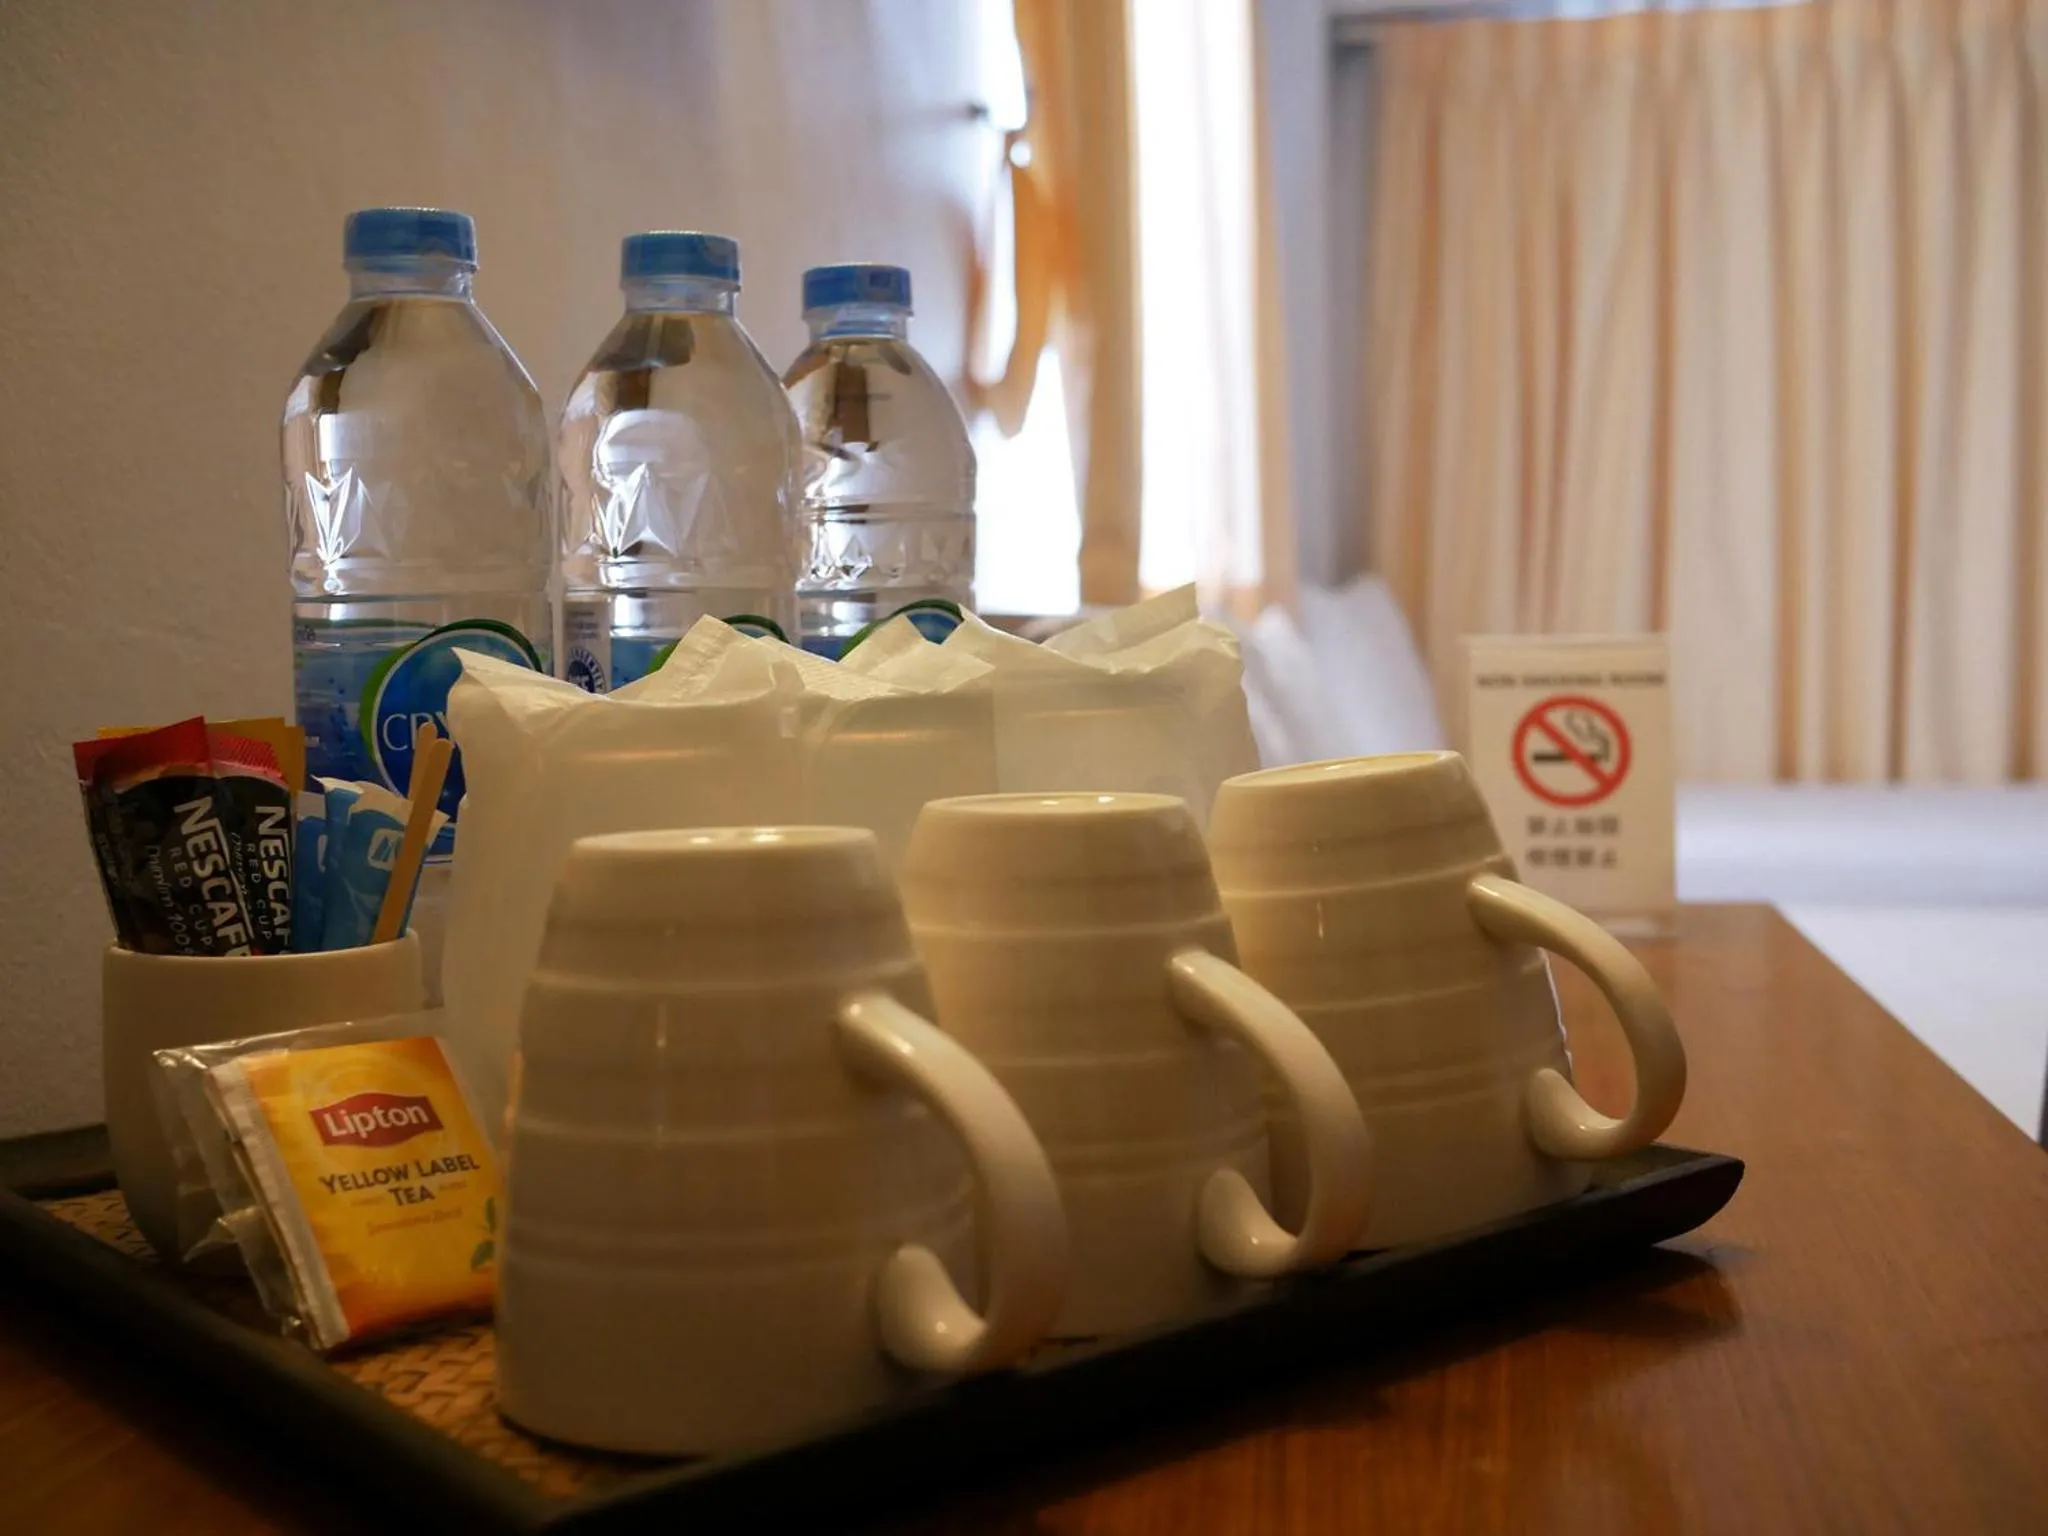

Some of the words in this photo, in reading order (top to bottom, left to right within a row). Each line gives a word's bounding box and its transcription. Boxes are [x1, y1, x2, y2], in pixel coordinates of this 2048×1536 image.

[169, 846, 194, 889] RED
[188, 904, 214, 947] CUP
[246, 843, 262, 884] RED
[255, 899, 273, 941] CUP
[254, 805, 291, 955] NESCAF
[323, 1105, 430, 1139] Lipton
[318, 1162, 409, 1194] YELLOW
[415, 1153, 481, 1178] LABEL
[388, 1184, 435, 1206] TEA
